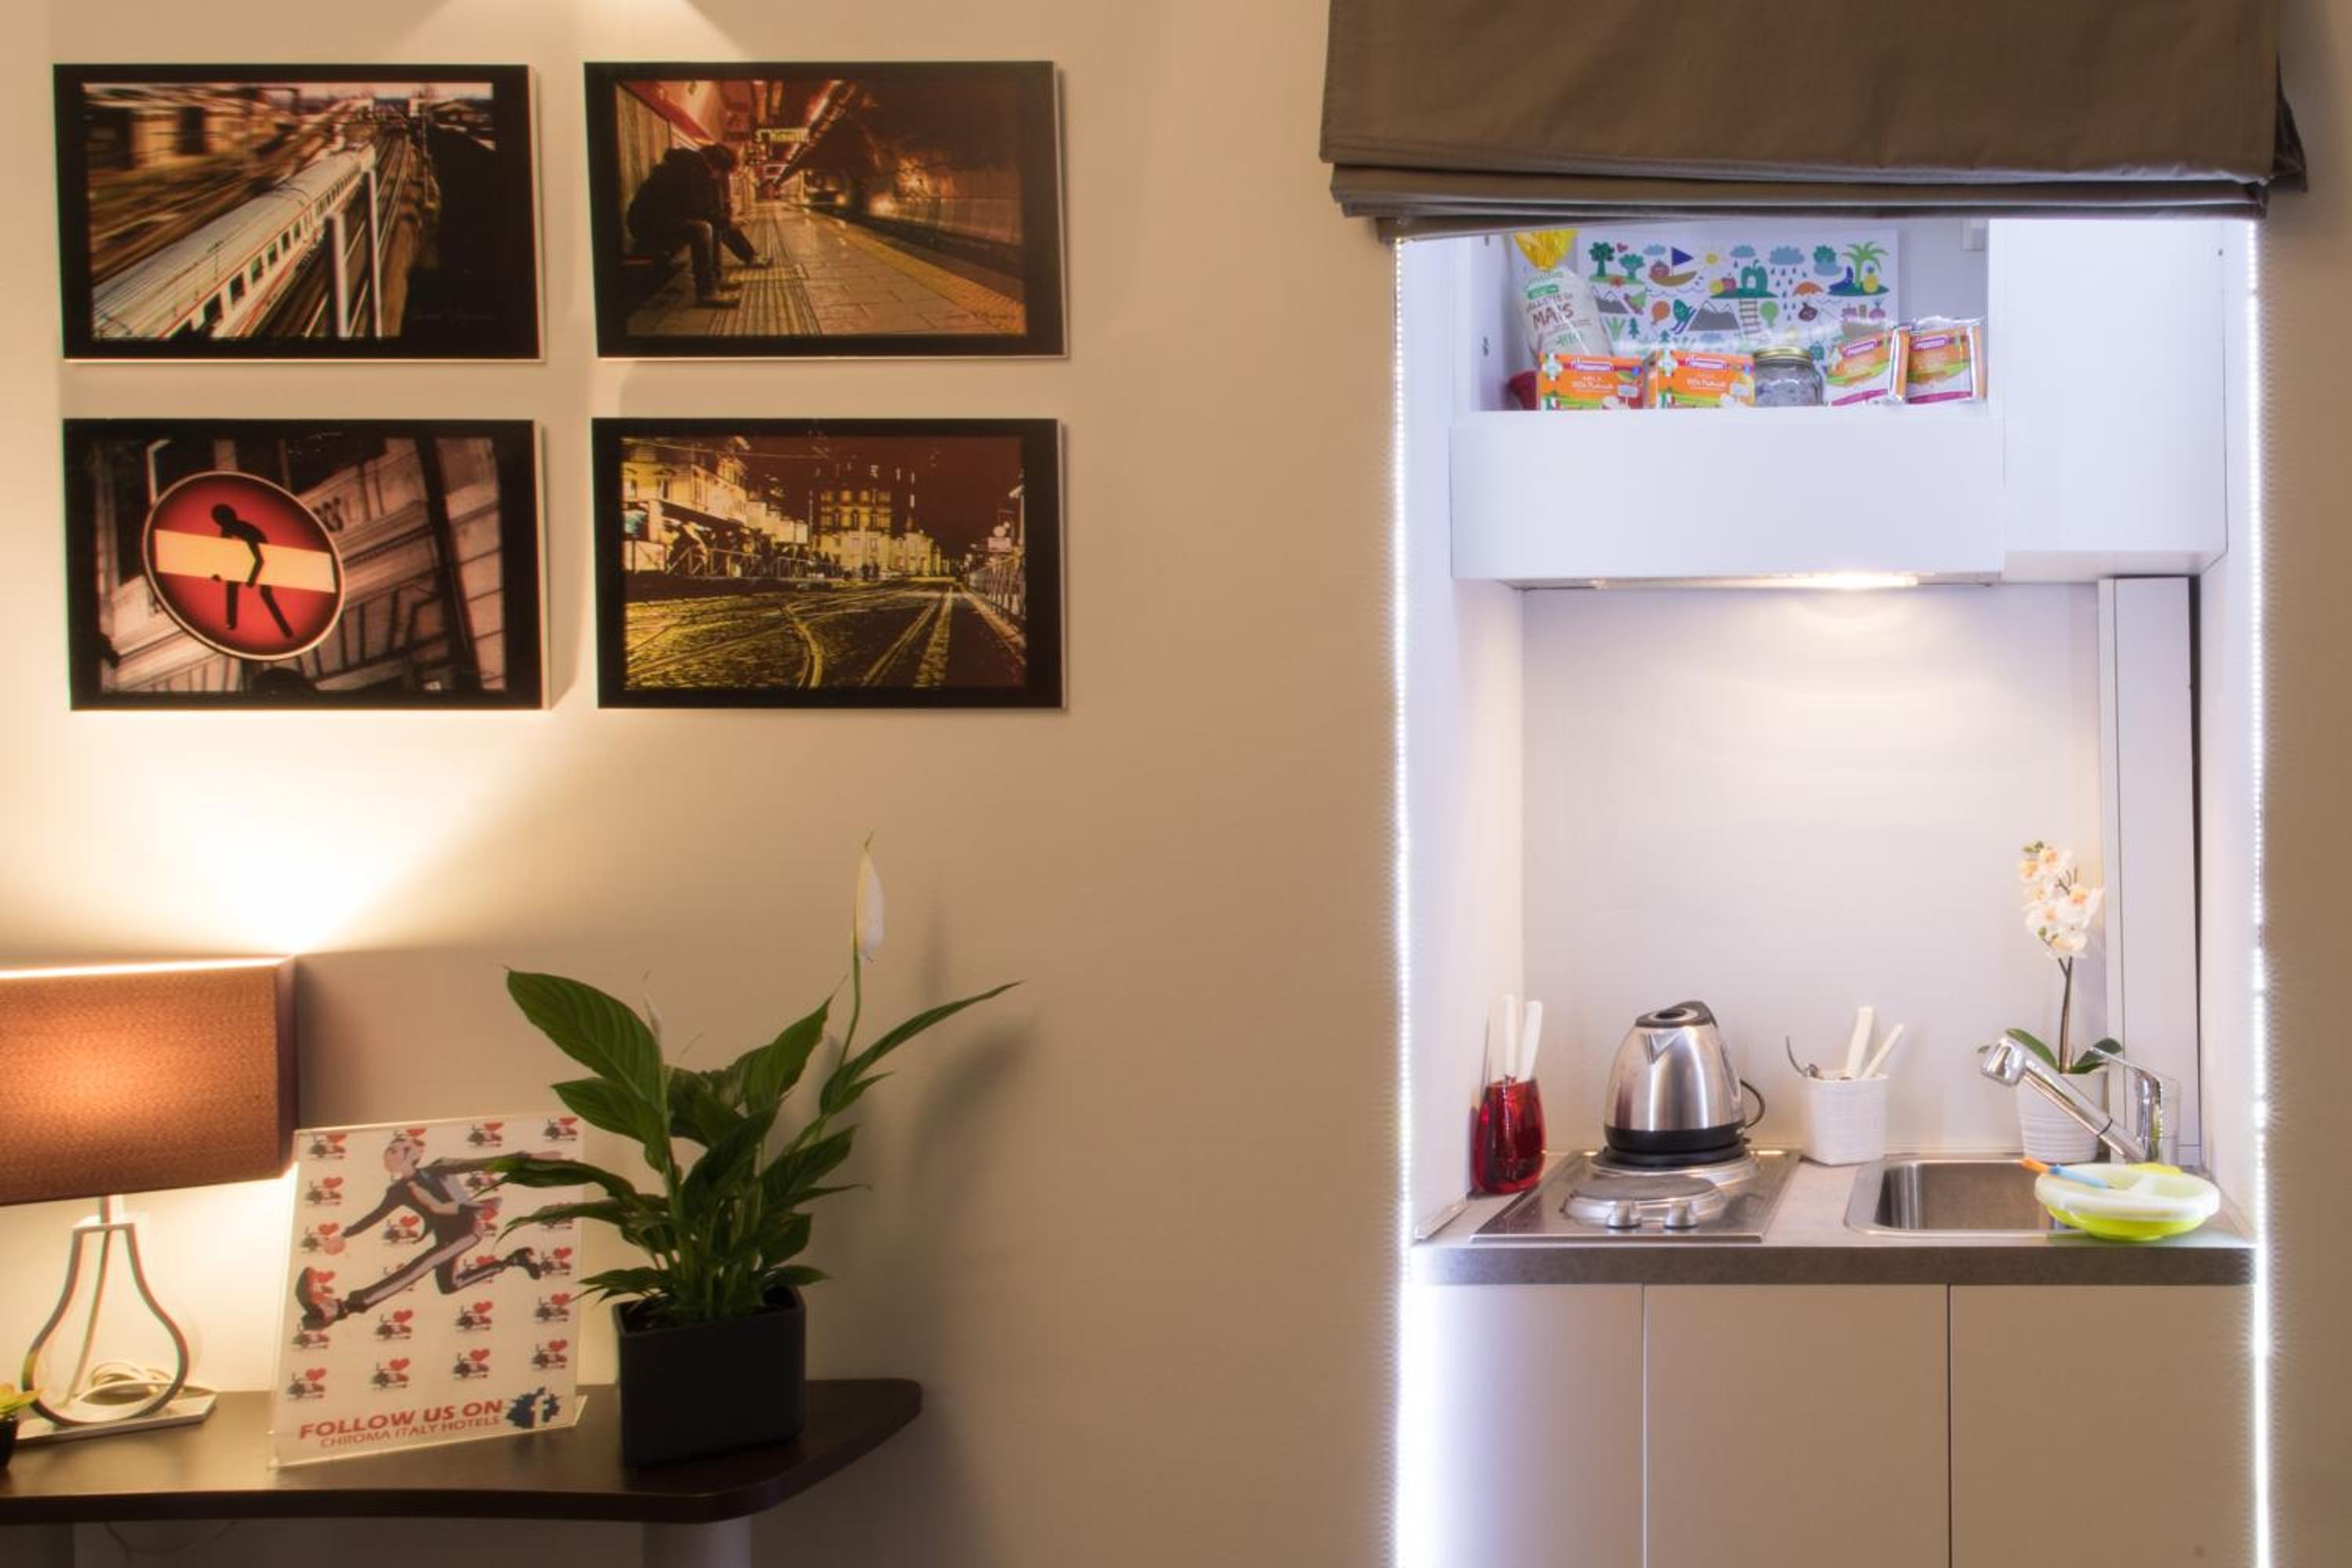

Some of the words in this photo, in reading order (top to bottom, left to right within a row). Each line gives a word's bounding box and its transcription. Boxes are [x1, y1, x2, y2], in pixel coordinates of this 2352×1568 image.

[299, 1410, 415, 1439] FOLLOW
[424, 1405, 456, 1422] US
[463, 1399, 503, 1417] ON
[320, 1429, 390, 1448] CHROMA
[394, 1424, 438, 1438] ITALY
[441, 1416, 500, 1432] HOTELS
